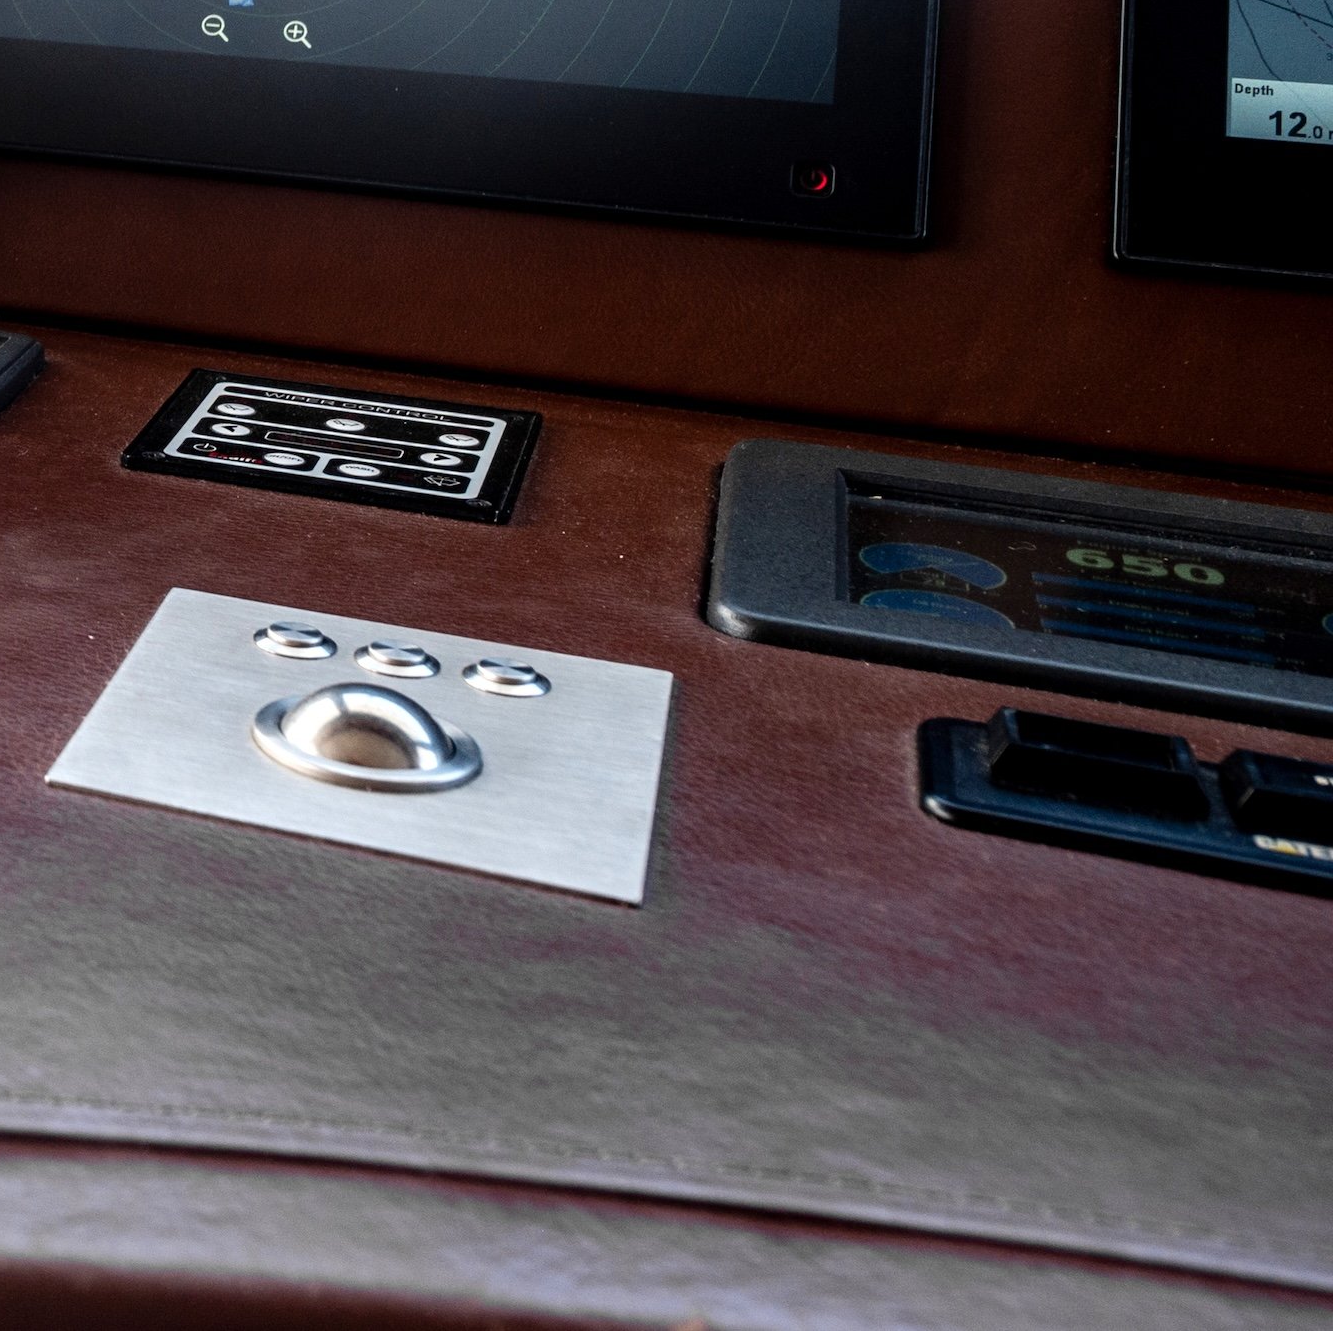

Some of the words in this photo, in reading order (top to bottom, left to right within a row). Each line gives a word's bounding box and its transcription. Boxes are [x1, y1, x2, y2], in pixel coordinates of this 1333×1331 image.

[1234, 83, 1274, 98] Depth
[1269, 110, 1323, 139] 12.0
[264, 390, 335, 406] WIPER
[341, 401, 451, 422] CONTROL
[1065, 547, 1226, 587] 650
